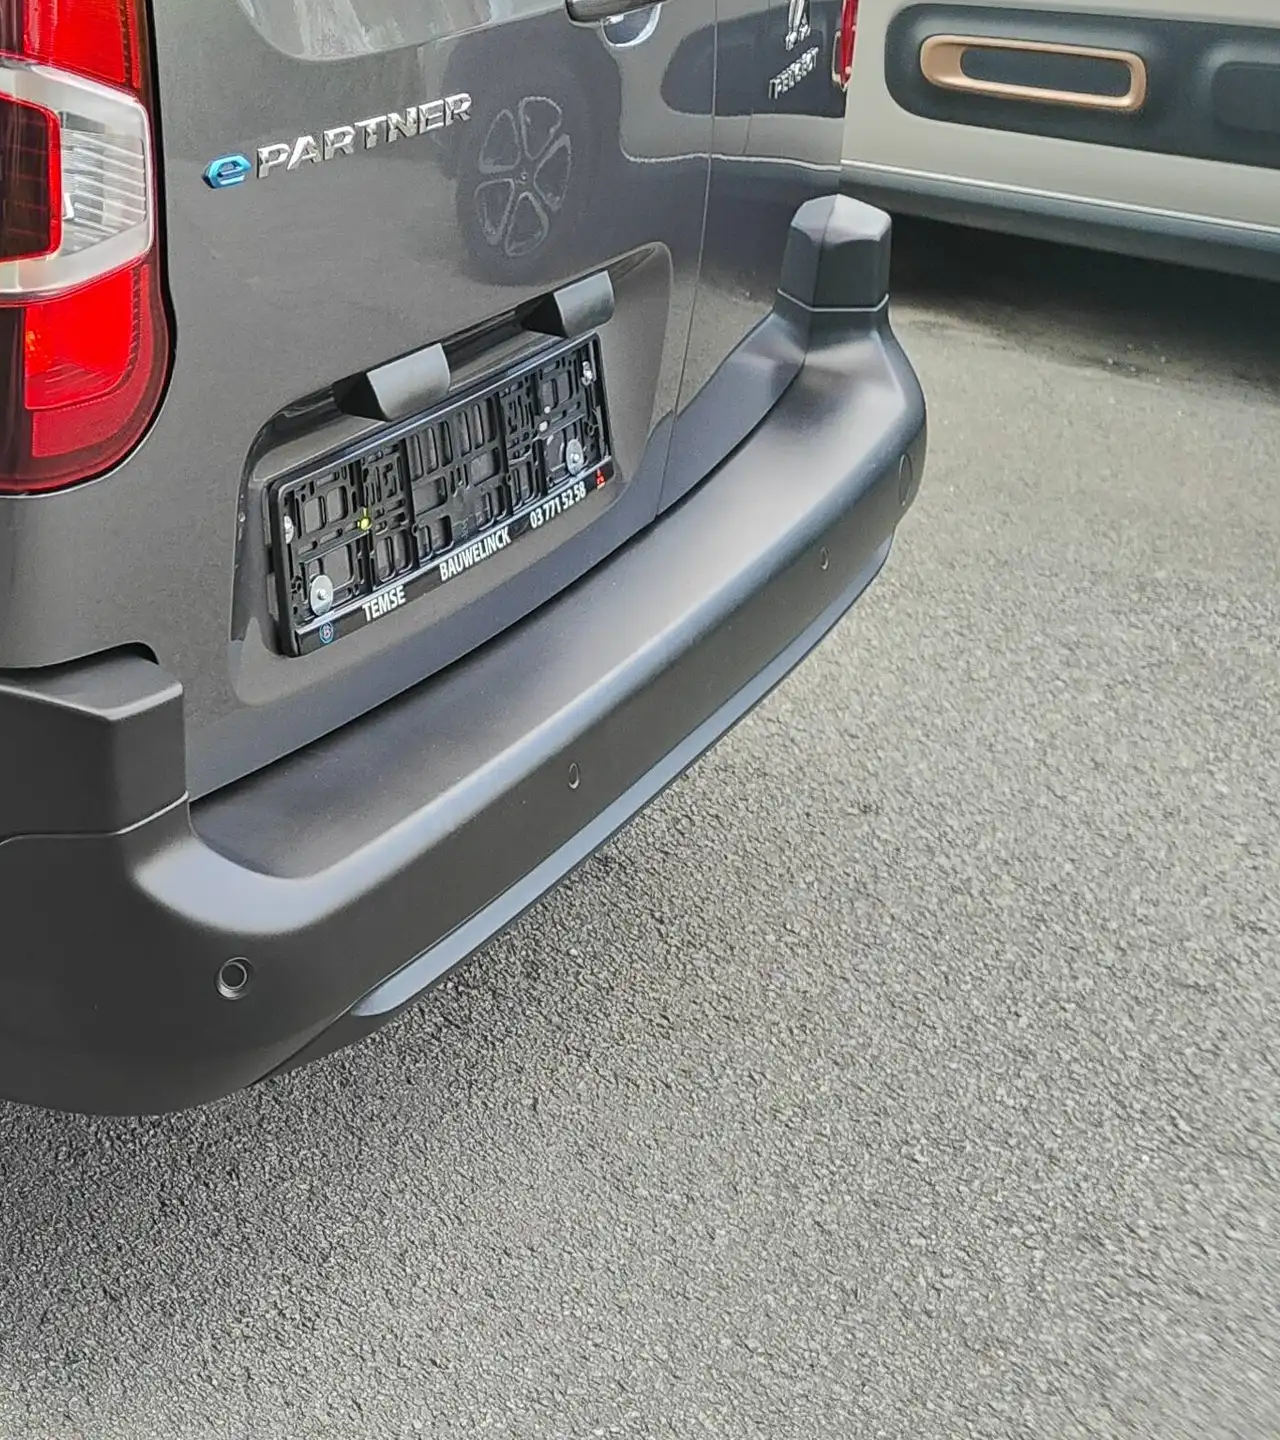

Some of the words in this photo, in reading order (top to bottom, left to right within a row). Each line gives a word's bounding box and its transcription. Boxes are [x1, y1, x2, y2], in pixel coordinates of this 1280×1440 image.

[362, 585, 406, 622] TEMSE
[439, 526, 512, 583] BAUWELINCK
[530, 507, 544, 529] 03
[543, 497, 561, 521] 771
[561, 489, 575, 510] 52
[574, 480, 587, 502] 58
